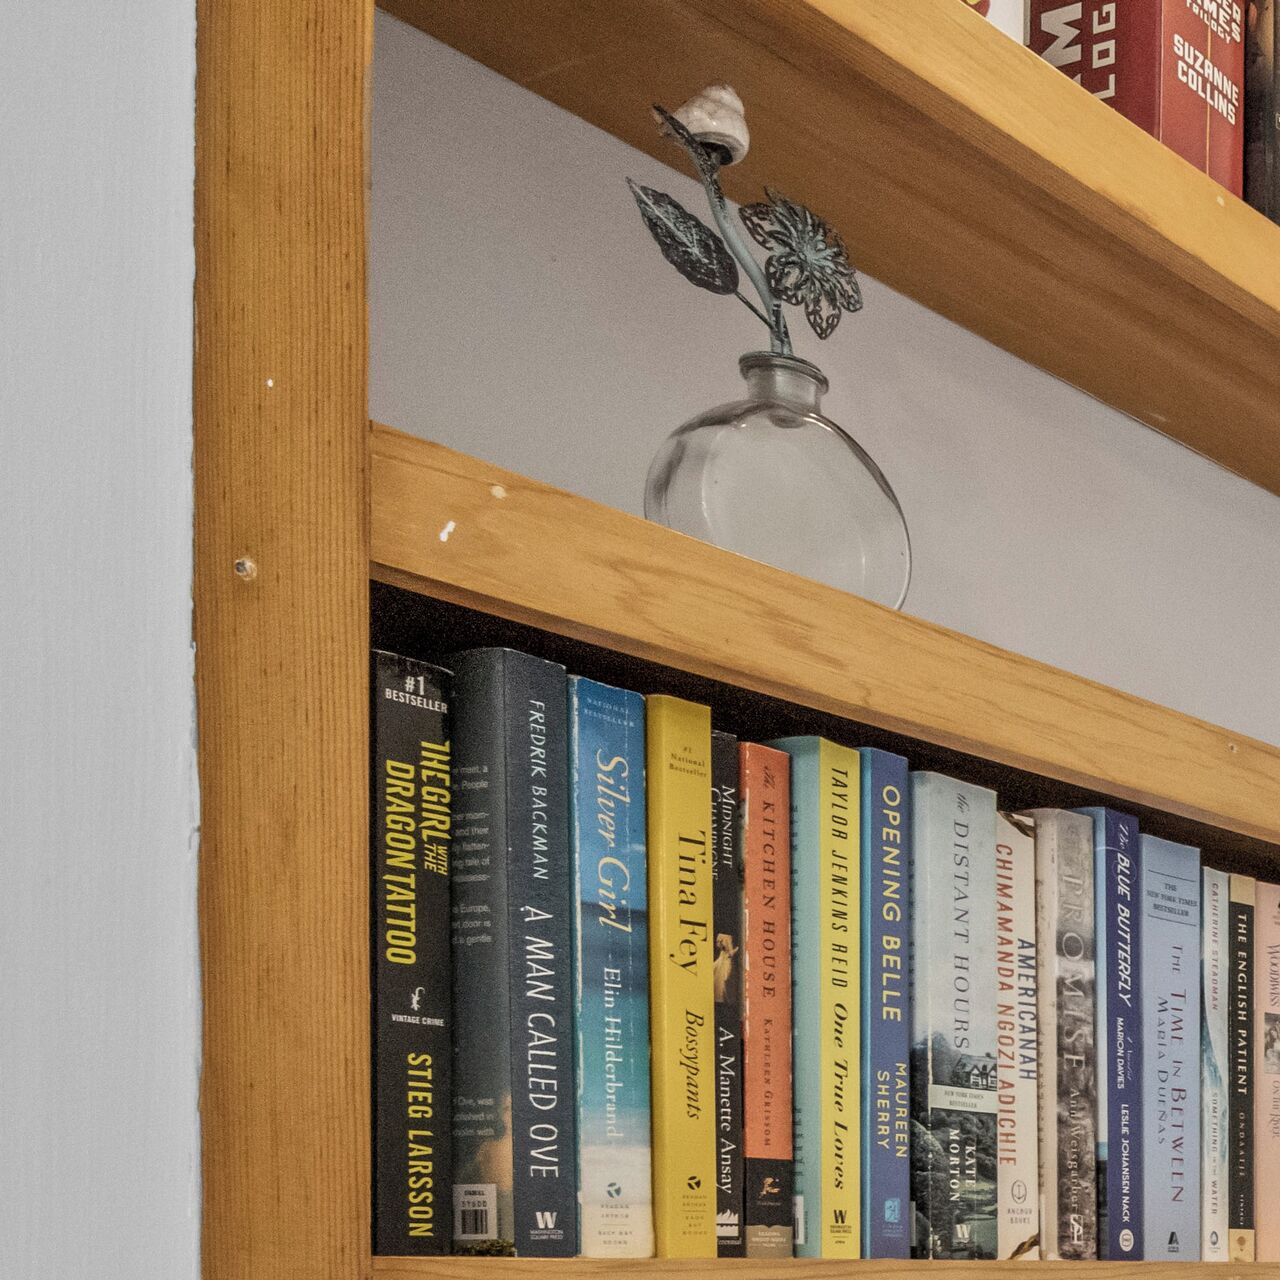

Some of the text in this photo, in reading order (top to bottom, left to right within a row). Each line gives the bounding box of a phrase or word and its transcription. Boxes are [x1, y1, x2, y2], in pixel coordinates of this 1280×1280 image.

[1173, 33, 1239, 107] SUZANNE
[1177, 60, 1236, 126] COLLINS
[385, 689, 447, 713] BESTSELLER
[405, 676, 425, 695] #1
[382, 759, 417, 965] DRAGON TATTOO
[419, 740, 452, 843] THE GIRL
[438, 845, 448, 876] WITH
[529, 700, 549, 879] FREDRIK BACKMAN
[596, 748, 632, 933] Silver Girl
[762, 802, 776, 998] KITCHEN HOUSE
[882, 785, 901, 1022] OPENING BELLE
[953, 822, 970, 1049] DISTANT HOURS
[1117, 852, 1132, 1008] BLUE BUTTERFLY
[524, 904, 559, 1178] A MAN CALLED OVE
[669, 830, 708, 1120] Tina Fey Bossypants
[831, 767, 849, 1190] TAYLOR JENKINS REID One True Loves
[996, 844, 1016, 1166] CHIMAMANDA NGOZI ADICHIE
[1017, 938, 1037, 1080] AMERICANAH
[1237, 914, 1248, 1095] THE ENGLISH PATIENT
[604, 967, 624, 1138] Elin Hilderbrand
[877, 1070, 890, 1150] SHERRY
[895, 1062, 908, 1158] MAUREEN
[1116, 1017, 1125, 1089] MARION DAVIES
[1121, 1104, 1129, 1134] LESLIE
[407, 1053, 434, 1237] STIEG LARSSON
[949, 1129, 961, 1201] MORTON
[965, 1145, 977, 1188] KATE
[1121, 1137, 1130, 1190] JOHANSEN
